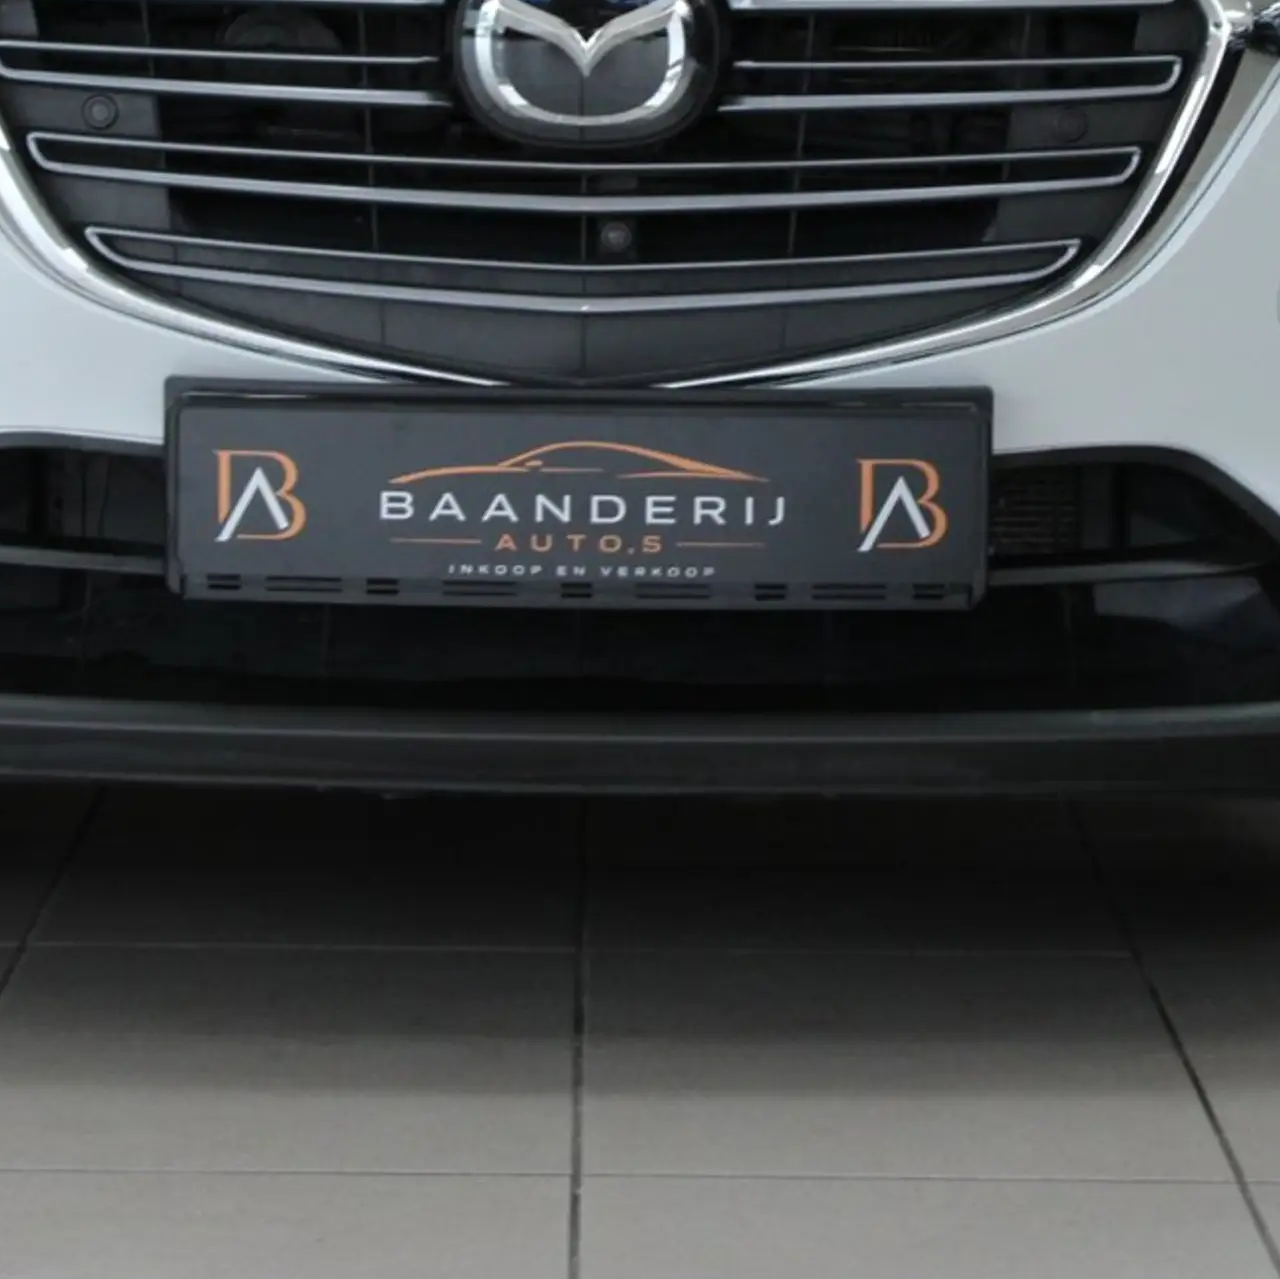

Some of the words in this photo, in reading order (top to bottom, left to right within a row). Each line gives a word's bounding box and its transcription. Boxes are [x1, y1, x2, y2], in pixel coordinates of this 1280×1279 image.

[379, 490, 786, 526] BAANDERIJ
[448, 564, 543, 576] INKOOP
[556, 565, 586, 577] EN
[599, 565, 716, 578] VERKOOP
